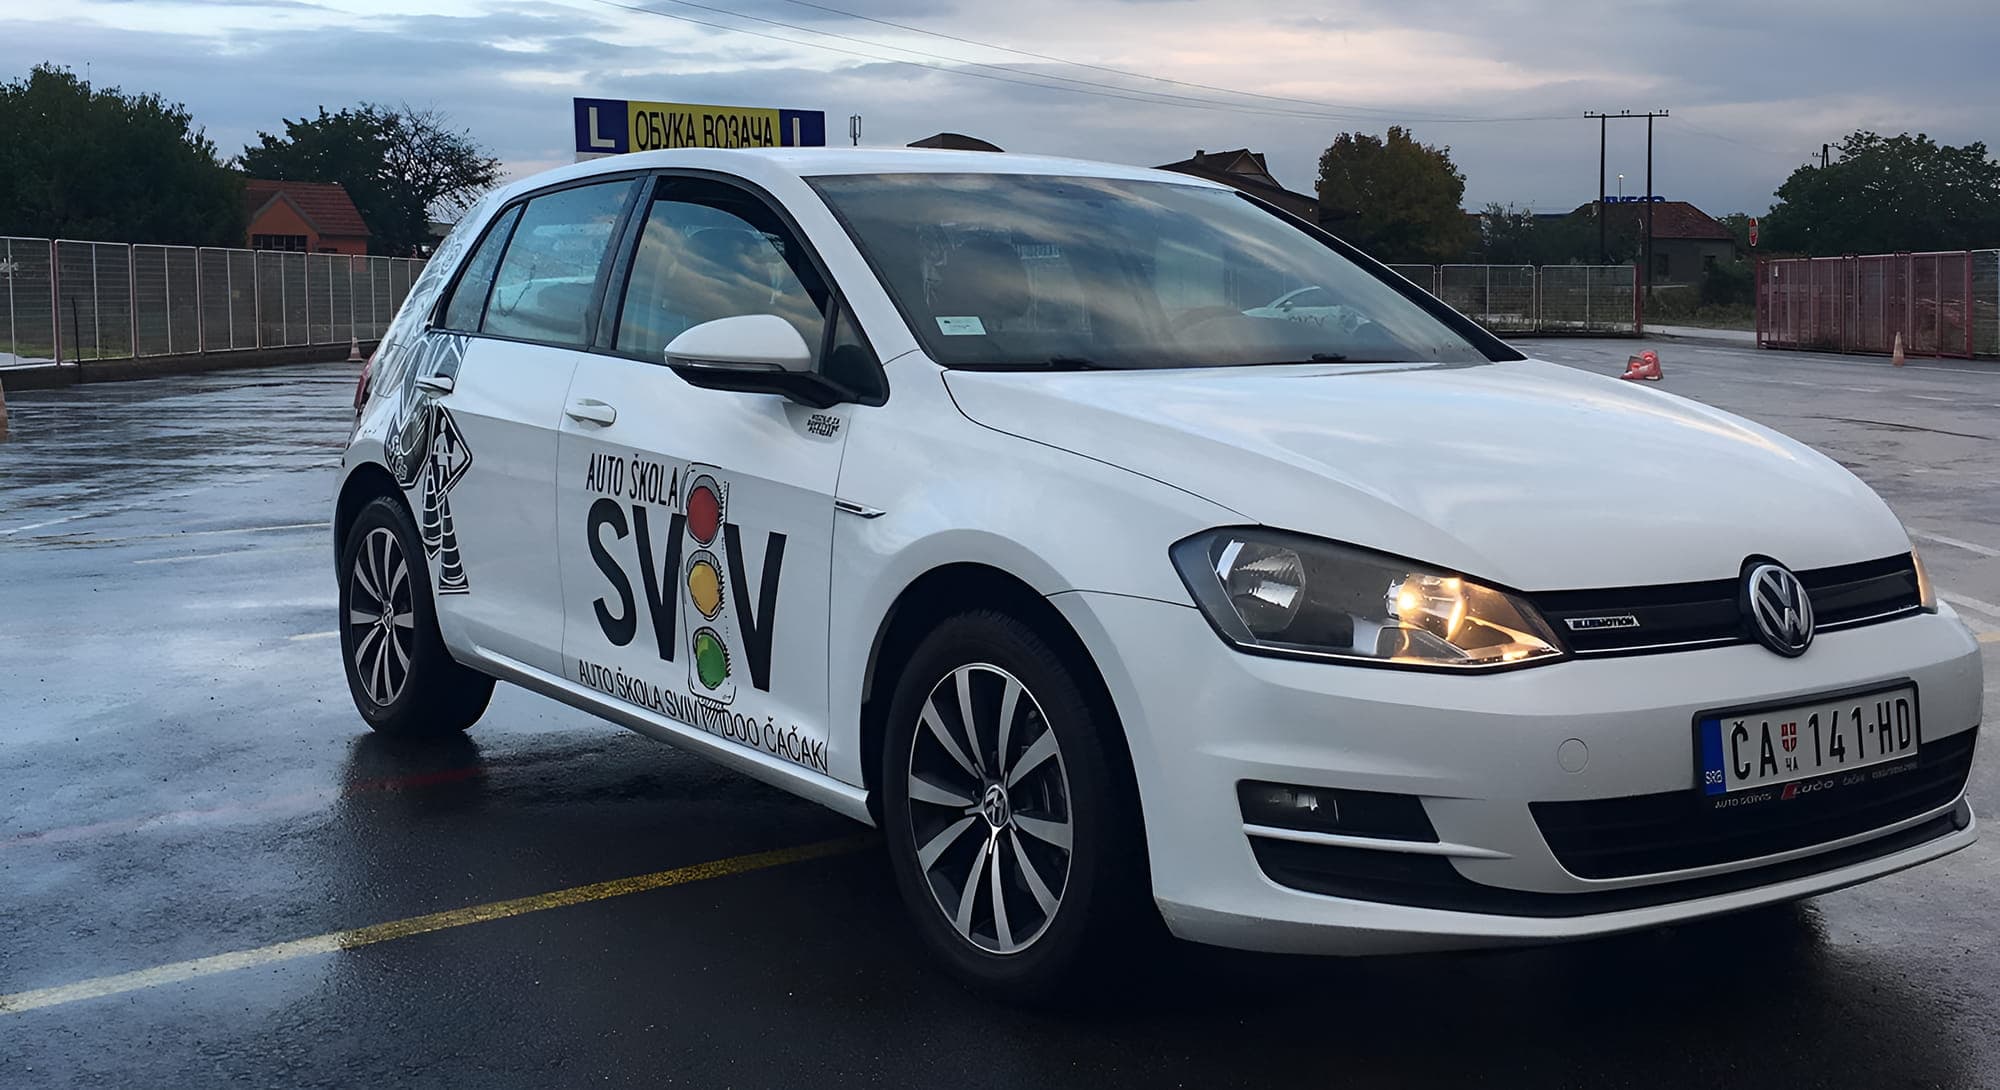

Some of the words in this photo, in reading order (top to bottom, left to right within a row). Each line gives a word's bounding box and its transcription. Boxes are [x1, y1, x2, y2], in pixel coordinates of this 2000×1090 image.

[588, 106, 616, 149] L
[635, 110, 697, 150] ОБУКА
[703, 114, 773, 149] ВОЗАЧА
[586, 453, 624, 496] AUTO
[629, 454, 680, 508] ŠKOLA
[579, 659, 614, 693] AUTO
[616, 666, 666, 713] ŠKOLA
[722, 708, 760, 746] DOO
[764, 716, 828, 774] ČAČAK
[1731, 720, 1778, 780] ČA
